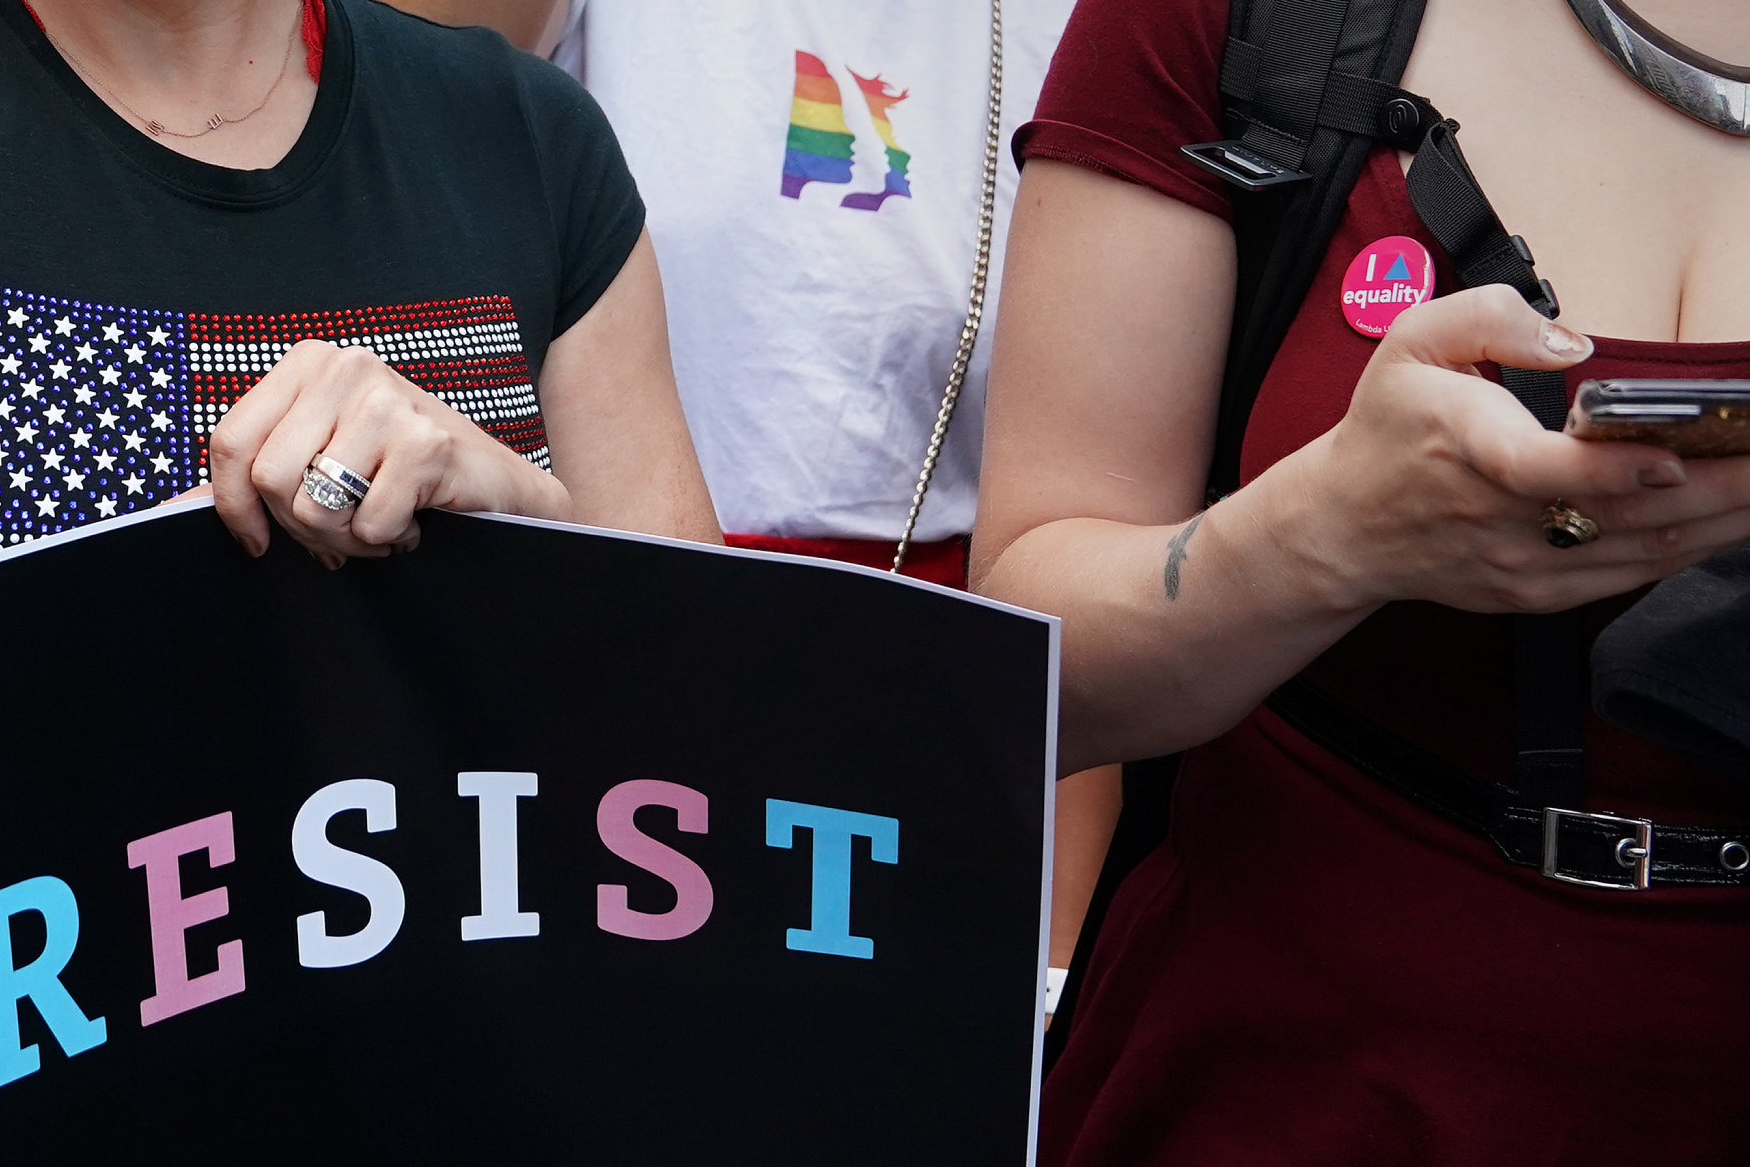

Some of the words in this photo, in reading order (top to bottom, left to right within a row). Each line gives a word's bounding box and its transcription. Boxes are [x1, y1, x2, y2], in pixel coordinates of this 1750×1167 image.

[1365, 253, 1377, 282] I
[1343, 282, 1427, 309] equality
[1355, 318, 1383, 333] Lambda
